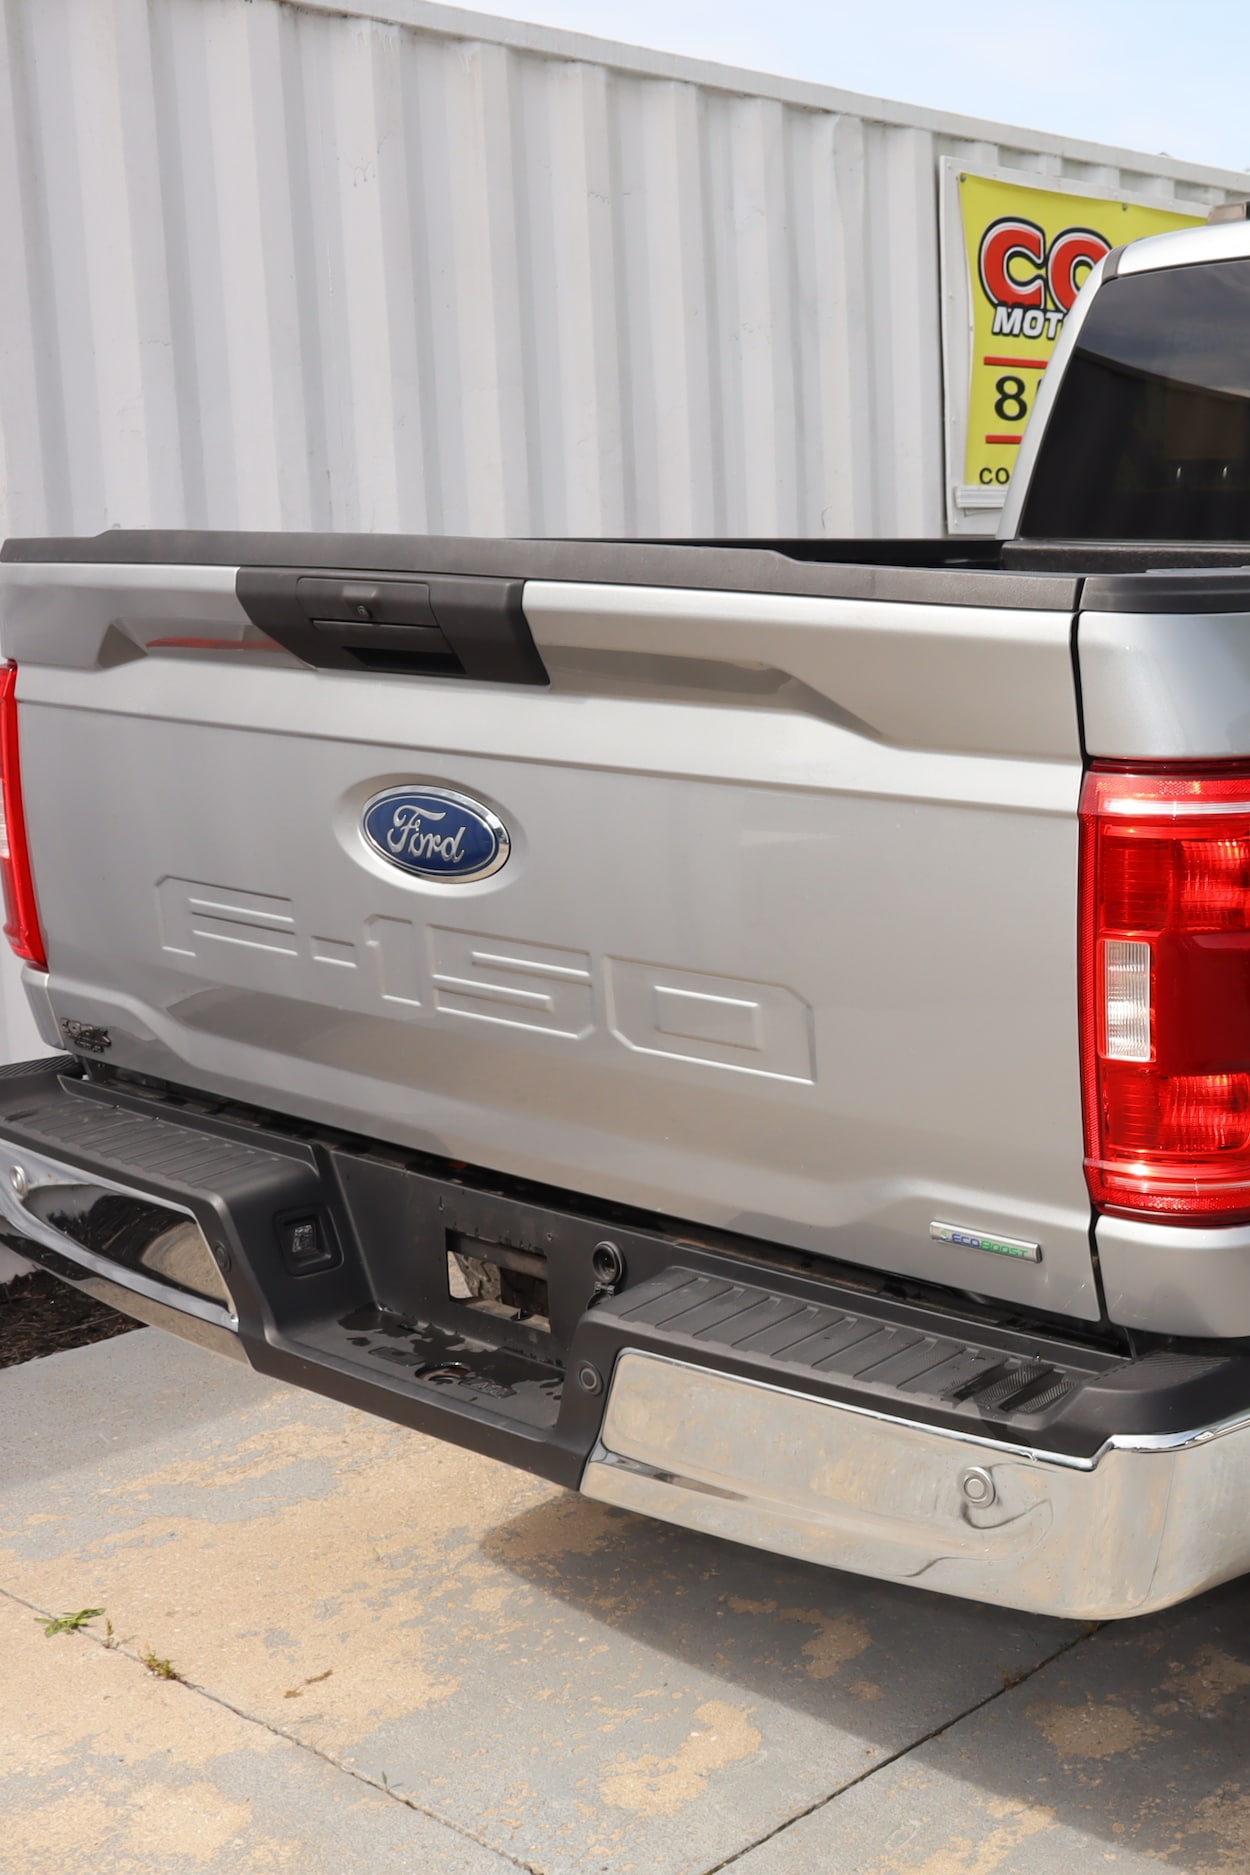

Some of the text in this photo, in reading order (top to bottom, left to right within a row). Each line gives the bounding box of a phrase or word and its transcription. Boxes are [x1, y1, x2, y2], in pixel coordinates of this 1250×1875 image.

[994, 375, 1043, 421] 8
[387, 804, 466, 863] Ford
[156, 873, 818, 1086] F-150
